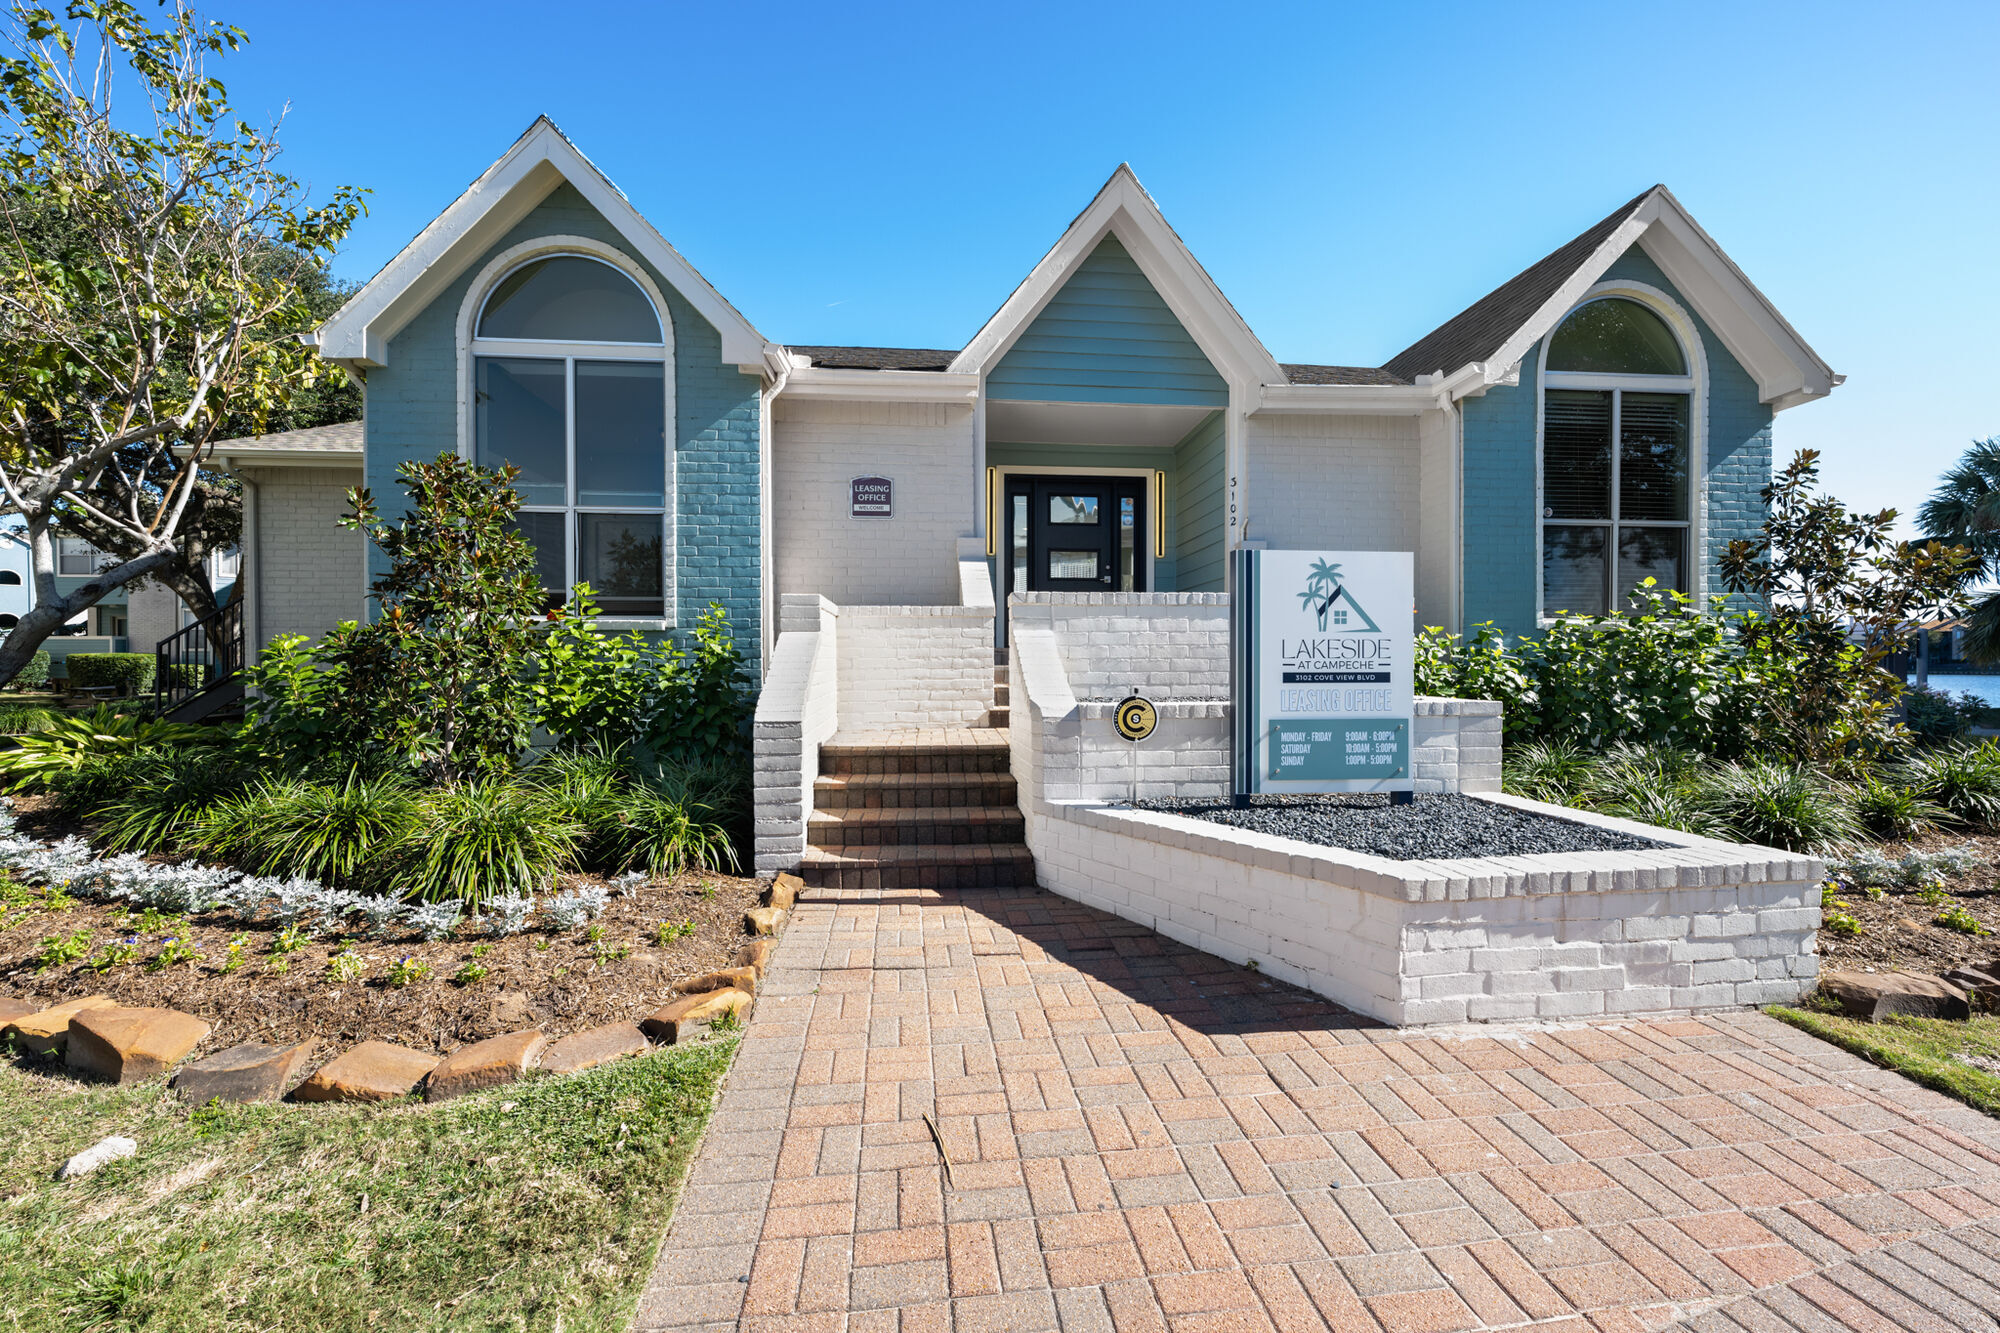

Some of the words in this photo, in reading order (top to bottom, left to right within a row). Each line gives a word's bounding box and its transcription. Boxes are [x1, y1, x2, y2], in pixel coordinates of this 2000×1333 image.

[854, 485, 890, 493] LEASING
[857, 494, 887, 502] OFFICE
[1282, 639, 1391, 659] LAKESIDE
[1297, 661, 1311, 670] AT
[1313, 661, 1374, 670] CAMPECHE
[1280, 689, 1341, 712] LEASING
[1344, 689, 1392, 711] OFFICE
[1280, 731, 1306, 742] MONDAY
[1311, 731, 1332, 742] FRIDAY
[1345, 731, 1368, 741] 9:00AM
[1372, 731, 1395, 741] 6:00PM
[1280, 743, 1312, 754] SATURDAY
[1345, 743, 1370, 753] 10:00AM
[1375, 742, 1398, 753] 5:00PM
[1280, 755, 1305, 766] SUNDAY
[1345, 755, 1366, 765] 1:00PM
[1370, 755, 1393, 765] 5:00PM
